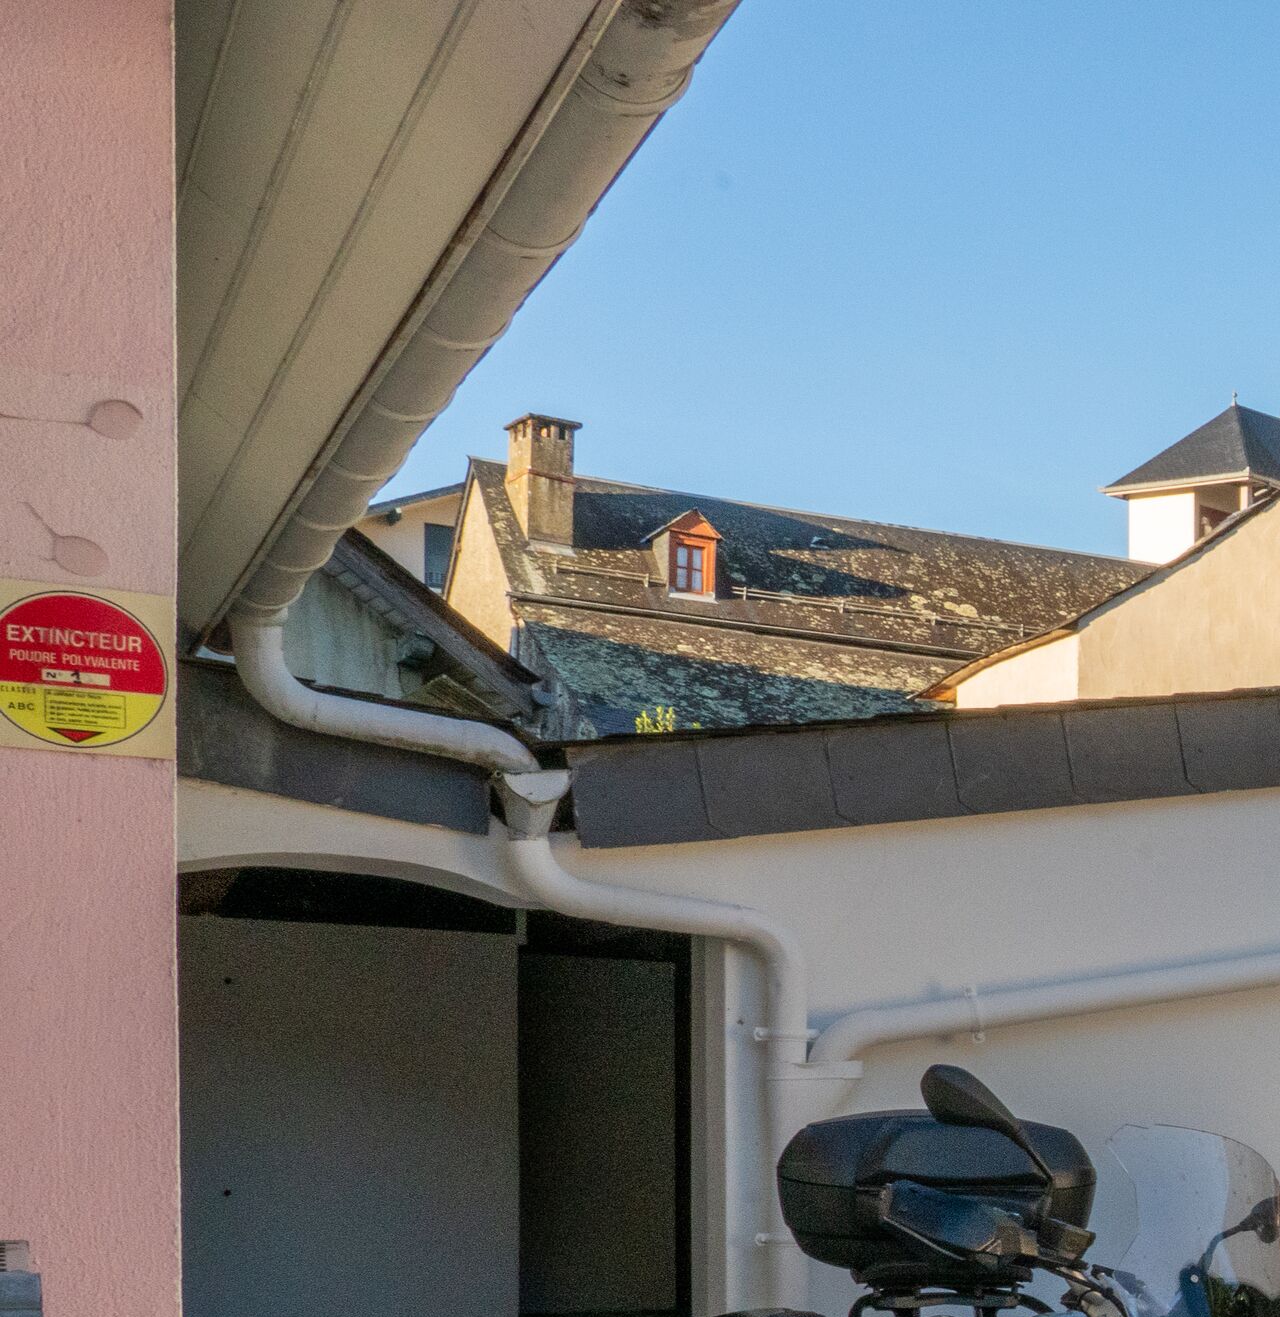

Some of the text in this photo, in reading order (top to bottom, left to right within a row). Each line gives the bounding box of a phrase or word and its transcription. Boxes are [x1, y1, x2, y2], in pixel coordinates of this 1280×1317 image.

[6, 624, 142, 653] EXTINCTEUR
[9, 648, 140, 672] POUDRE POLYVALENTE
[8, 701, 35, 711] ABC
